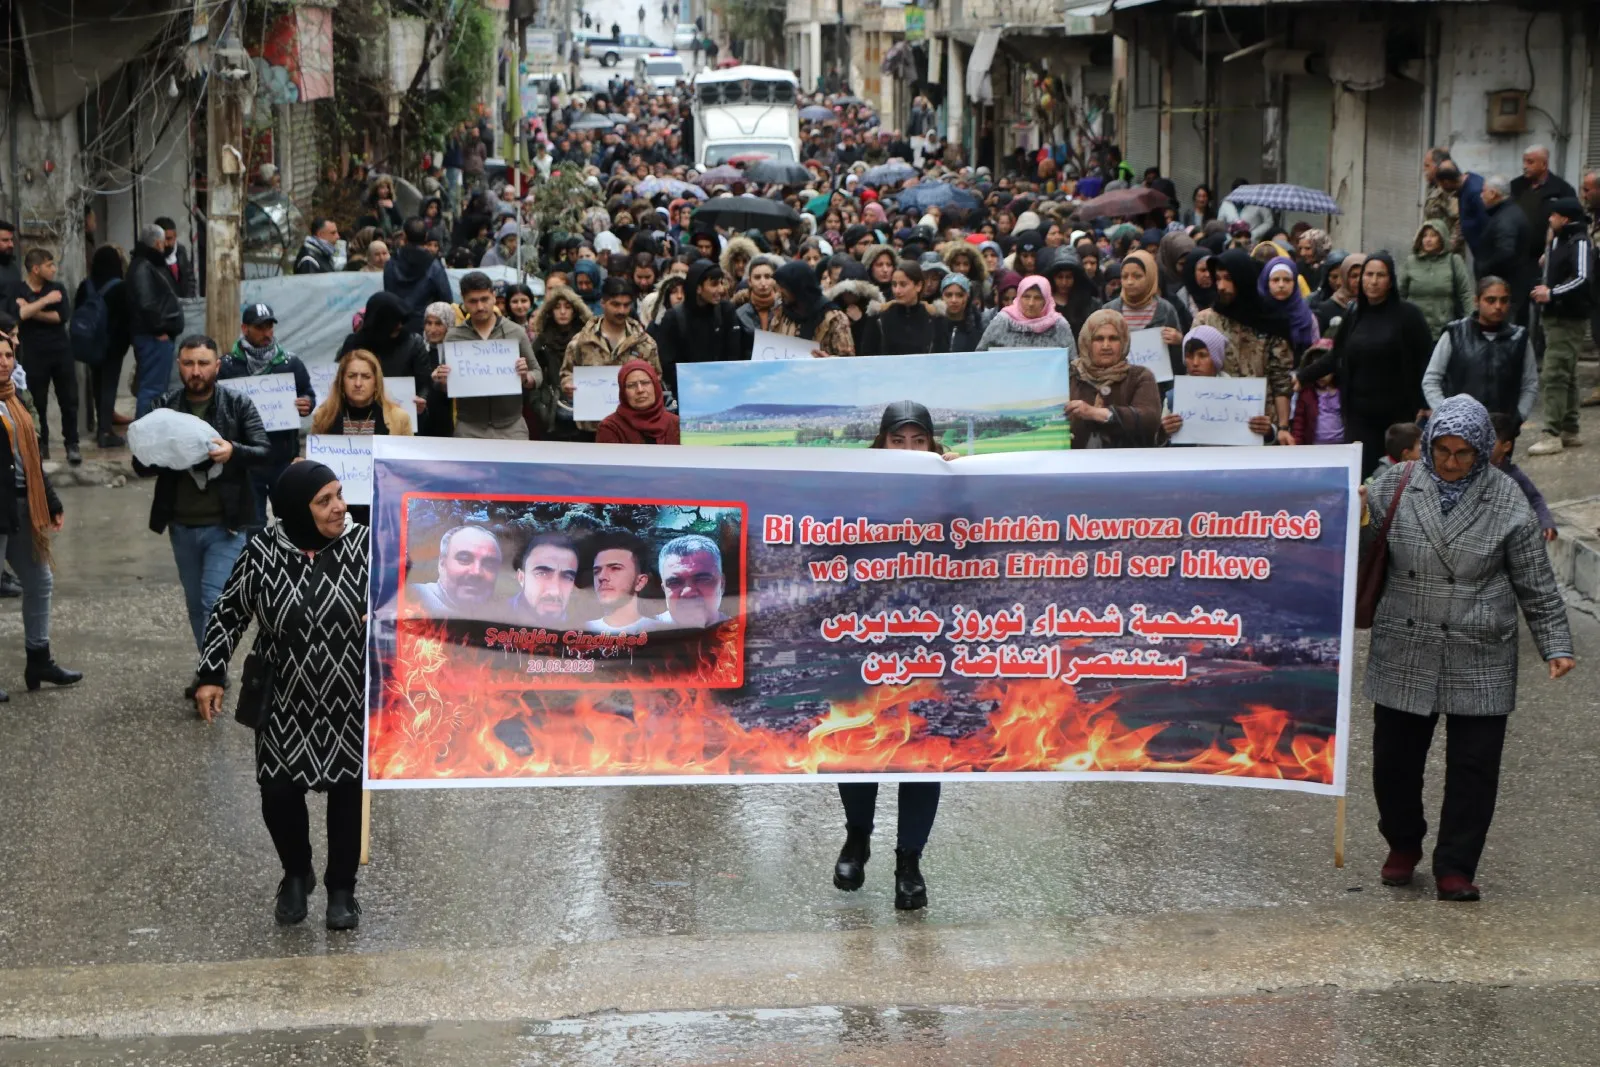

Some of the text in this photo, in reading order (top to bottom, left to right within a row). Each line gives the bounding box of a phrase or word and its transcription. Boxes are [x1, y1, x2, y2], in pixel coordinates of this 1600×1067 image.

[763, 509, 1320, 550] Bi fedekariya Şehîdên Newroza Cindirêsê
[808, 549, 1270, 582] wê serhildana Efrînê bi ser bikeve
[820, 602, 1243, 647] بتضحية شهداء نوروز جنديرس
[860, 644, 1188, 685] ستنتصر انتفاضة عفرين
